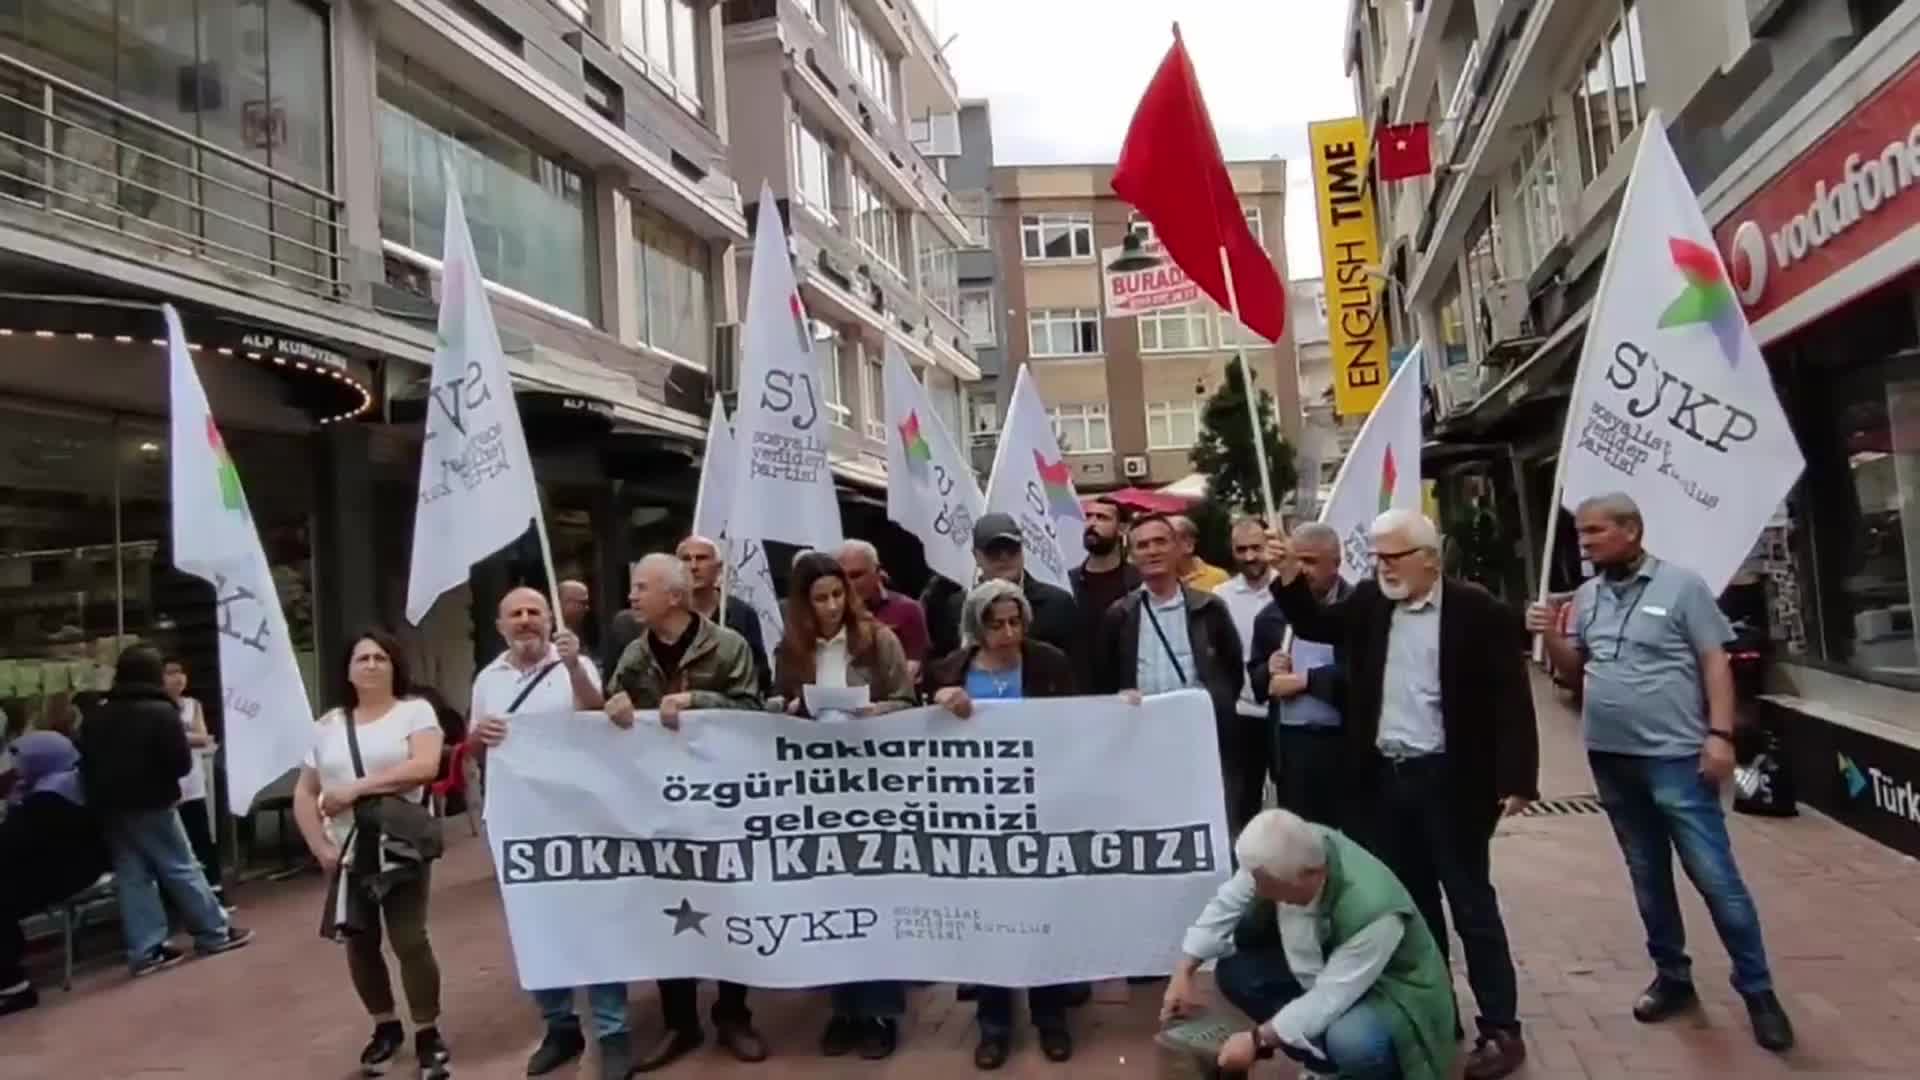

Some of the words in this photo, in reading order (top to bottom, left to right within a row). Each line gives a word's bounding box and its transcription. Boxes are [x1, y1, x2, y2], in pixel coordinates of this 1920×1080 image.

[1324, 140, 1364, 228] TIME
[1112, 266, 1188, 296] BURAD
[1335, 239, 1380, 388] ENGLISH
[242, 334, 274, 349] ALP
[663, 766, 1035, 808] özgürlüklerimizi
[1868, 767, 1920, 824] Türk
[744, 802, 1037, 839] geleceğimizi
[508, 838, 748, 881] SOKAKTA
